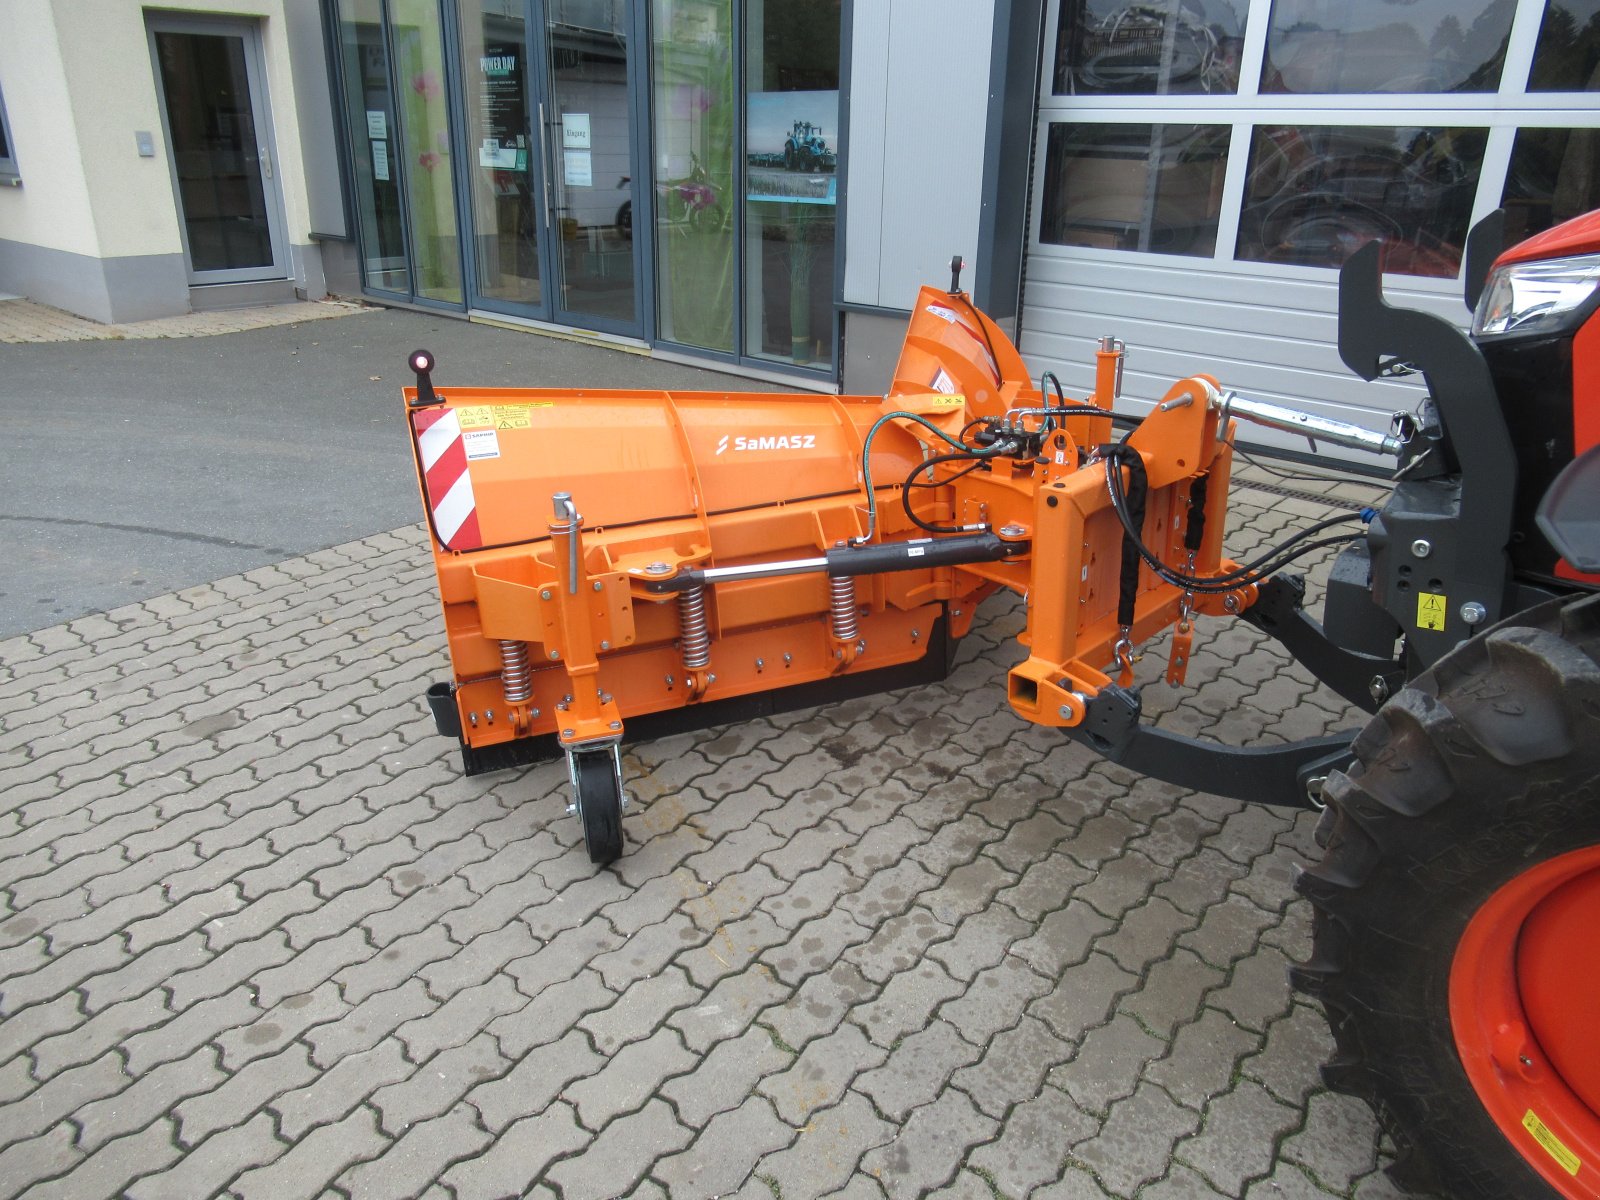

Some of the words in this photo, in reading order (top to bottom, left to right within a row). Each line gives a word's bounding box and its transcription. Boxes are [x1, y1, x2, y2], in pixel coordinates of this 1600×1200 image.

[480, 56, 502, 72] POWER
[502, 56, 515, 71] DAY
[566, 129, 586, 139] Eingang
[734, 435, 816, 451] SaMASZ
